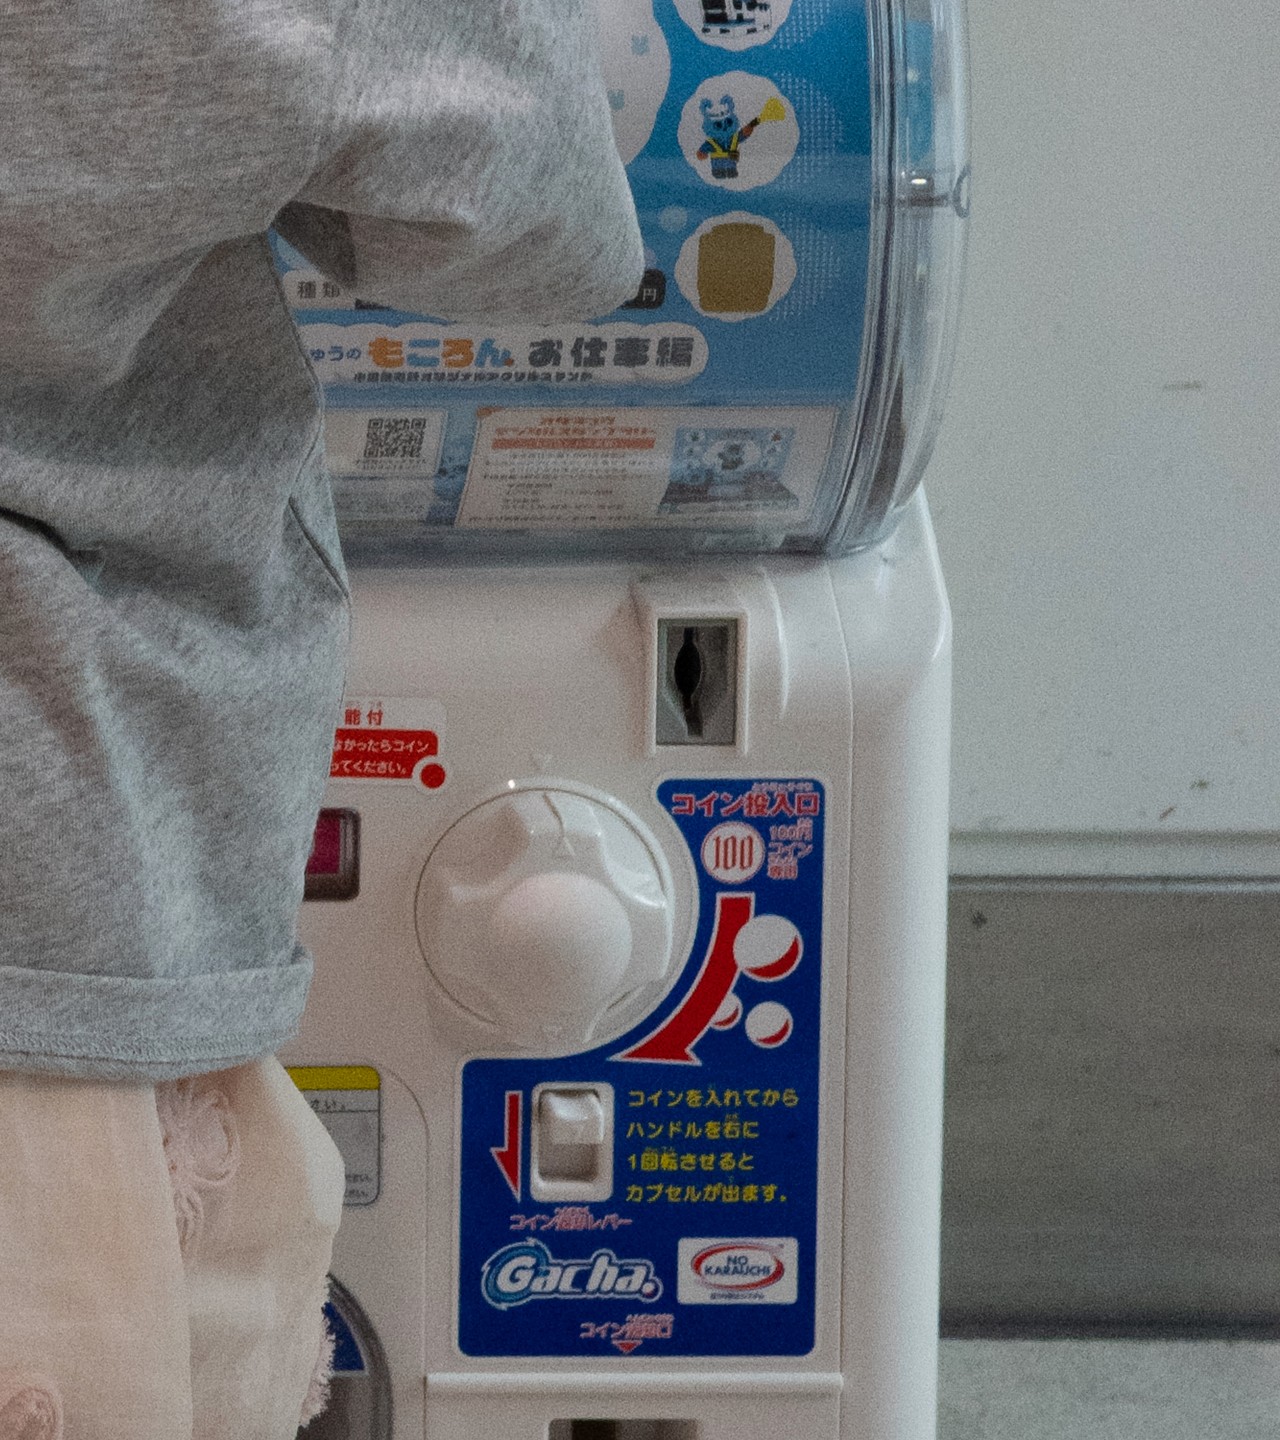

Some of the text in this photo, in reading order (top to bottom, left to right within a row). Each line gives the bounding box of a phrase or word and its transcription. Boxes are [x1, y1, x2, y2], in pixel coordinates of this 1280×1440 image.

[527, 336, 695, 368] お仕事編
[672, 793, 820, 818] コイン投入口
[713, 835, 754, 870] 100
[628, 1089, 799, 1108] コインを入れてから
[626, 1121, 760, 1140] ハンドルを右に
[628, 1152, 754, 1171] 1回転させると
[626, 1184, 788, 1203] カプセルが出ます。
[726, 1255, 749, 1266] NO
[705, 1265, 771, 1277] KARAUCHI
